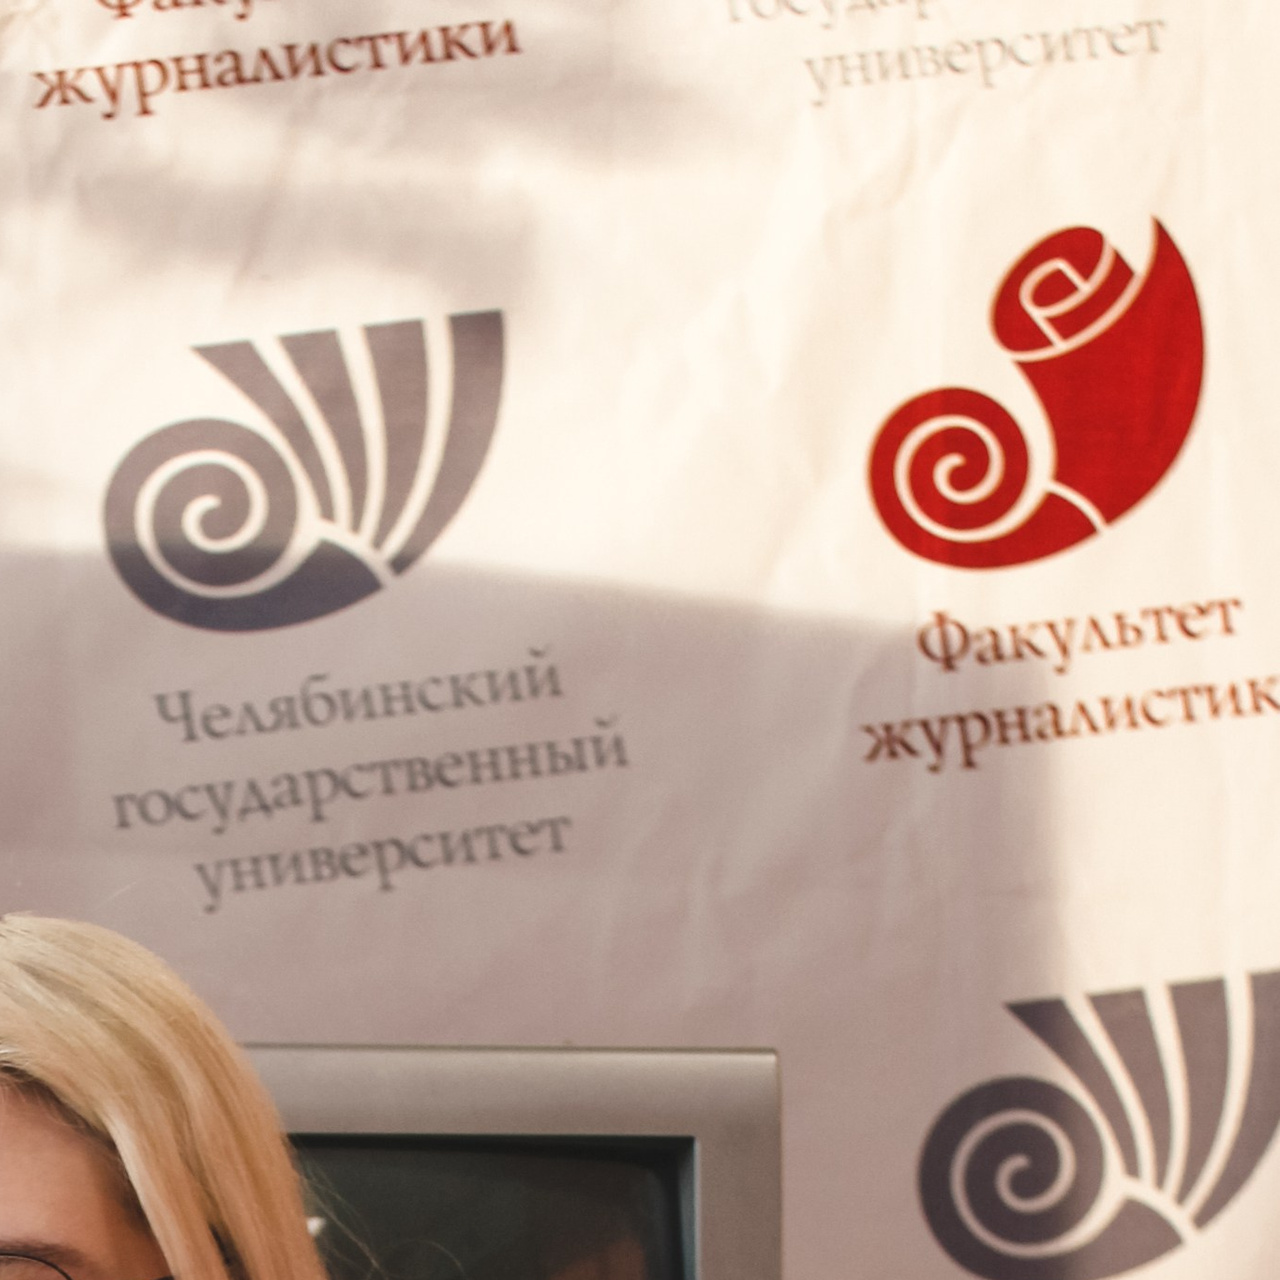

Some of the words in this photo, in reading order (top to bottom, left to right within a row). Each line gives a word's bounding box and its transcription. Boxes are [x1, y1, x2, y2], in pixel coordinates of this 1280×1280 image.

[32, 19, 523, 119] журналистики
[804, 18, 1166, 107] университет
[917, 597, 1243, 675] Факультет
[152, 643, 564, 743] Челябинский
[859, 674, 1280, 774] журналистик
[111, 714, 629, 836] государственный
[193, 815, 573, 915] университет
